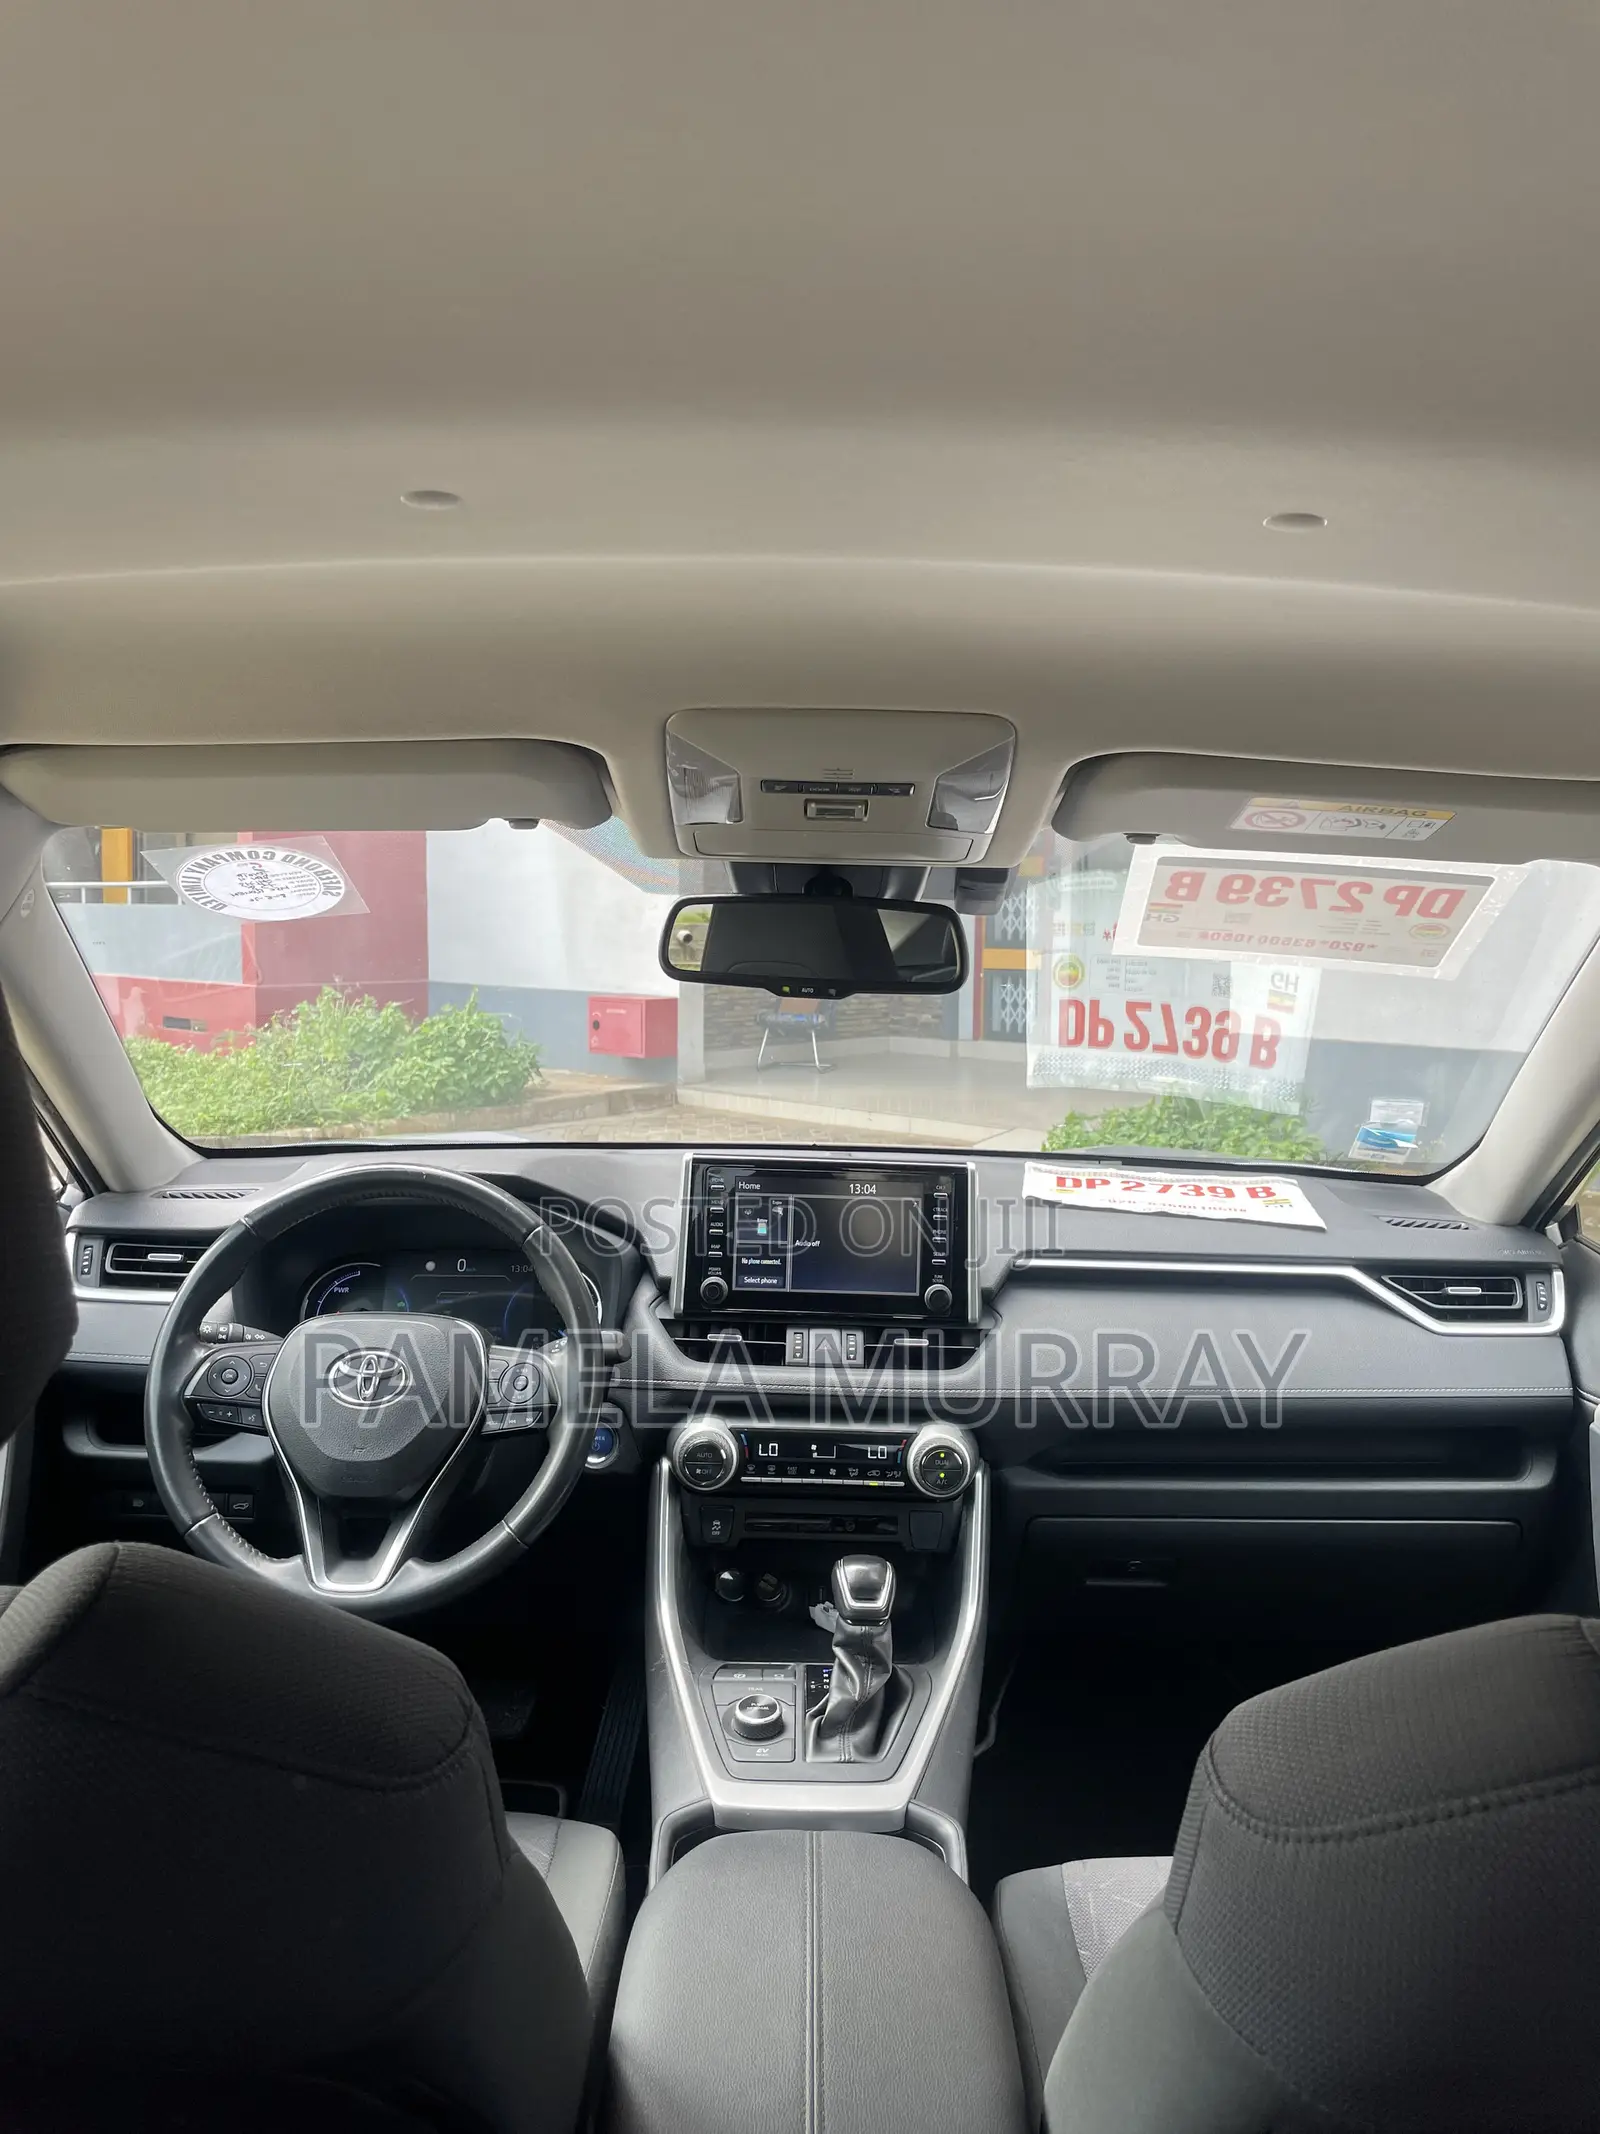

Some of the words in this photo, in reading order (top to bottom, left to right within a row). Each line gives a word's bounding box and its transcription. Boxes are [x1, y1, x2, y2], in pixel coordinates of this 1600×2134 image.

[1336, 805, 1428, 817] AIRBAG
[738, 1181, 761, 1190] Home
[849, 1183, 877, 1195] 13:04
[1056, 1176, 1110, 1190] DP
[1121, 1180, 1236, 1199] 2739
[1246, 1186, 1277, 1199] B
[795, 1239, 812, 1247] Audio
[457, 1258, 467, 1272] 0
[744, 1276, 760, 1284] Select
[761, 1277, 778, 1285] phone
[333, 1286, 350, 1294] PWR
[758, 1442, 779, 1457] LO
[867, 1445, 888, 1459] LO
